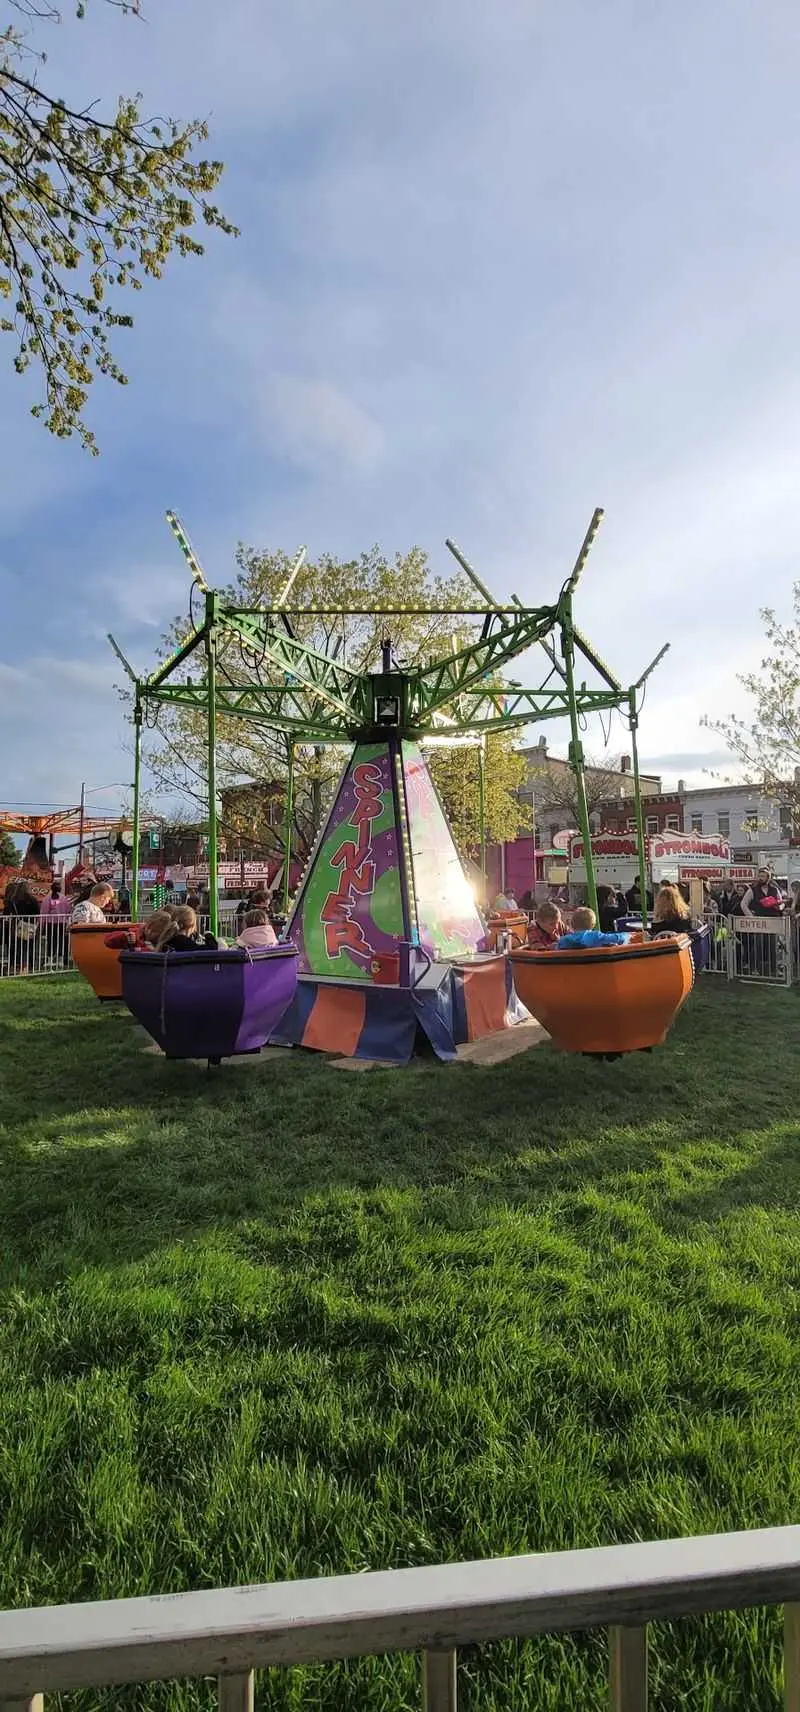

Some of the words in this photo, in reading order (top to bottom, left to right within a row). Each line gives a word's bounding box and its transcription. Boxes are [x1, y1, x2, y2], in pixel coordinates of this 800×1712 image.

[655, 840, 729, 859] STROMBOLI
[320, 763, 384, 959] SPINNER
[729, 869, 753, 878] PIZZA
[740, 919, 767, 928] ENTER
